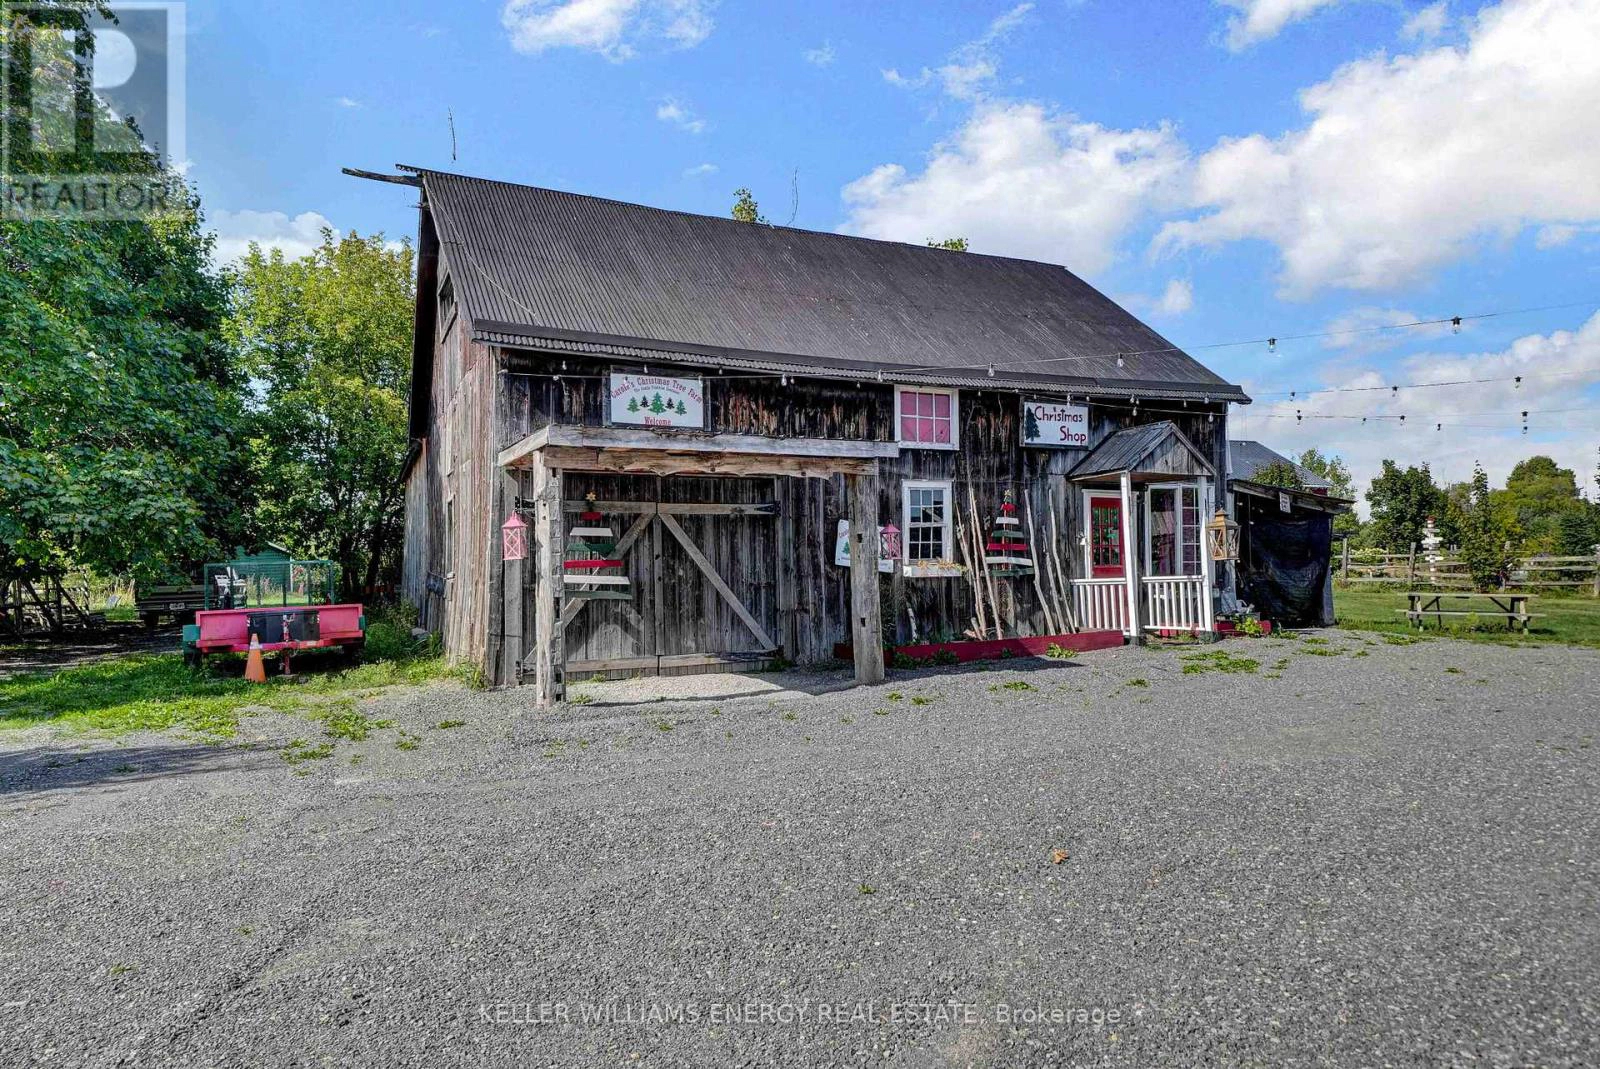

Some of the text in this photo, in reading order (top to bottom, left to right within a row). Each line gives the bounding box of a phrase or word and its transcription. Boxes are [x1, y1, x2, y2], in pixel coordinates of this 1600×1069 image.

[637, 376, 669, 386] Christmas
[672, 380, 687, 392] Tree
[688, 388, 702, 403] Farm
[644, 416, 672, 426] Welcome
[1034, 405, 1083, 422] Christmas
[1060, 425, 1086, 444] Shop
